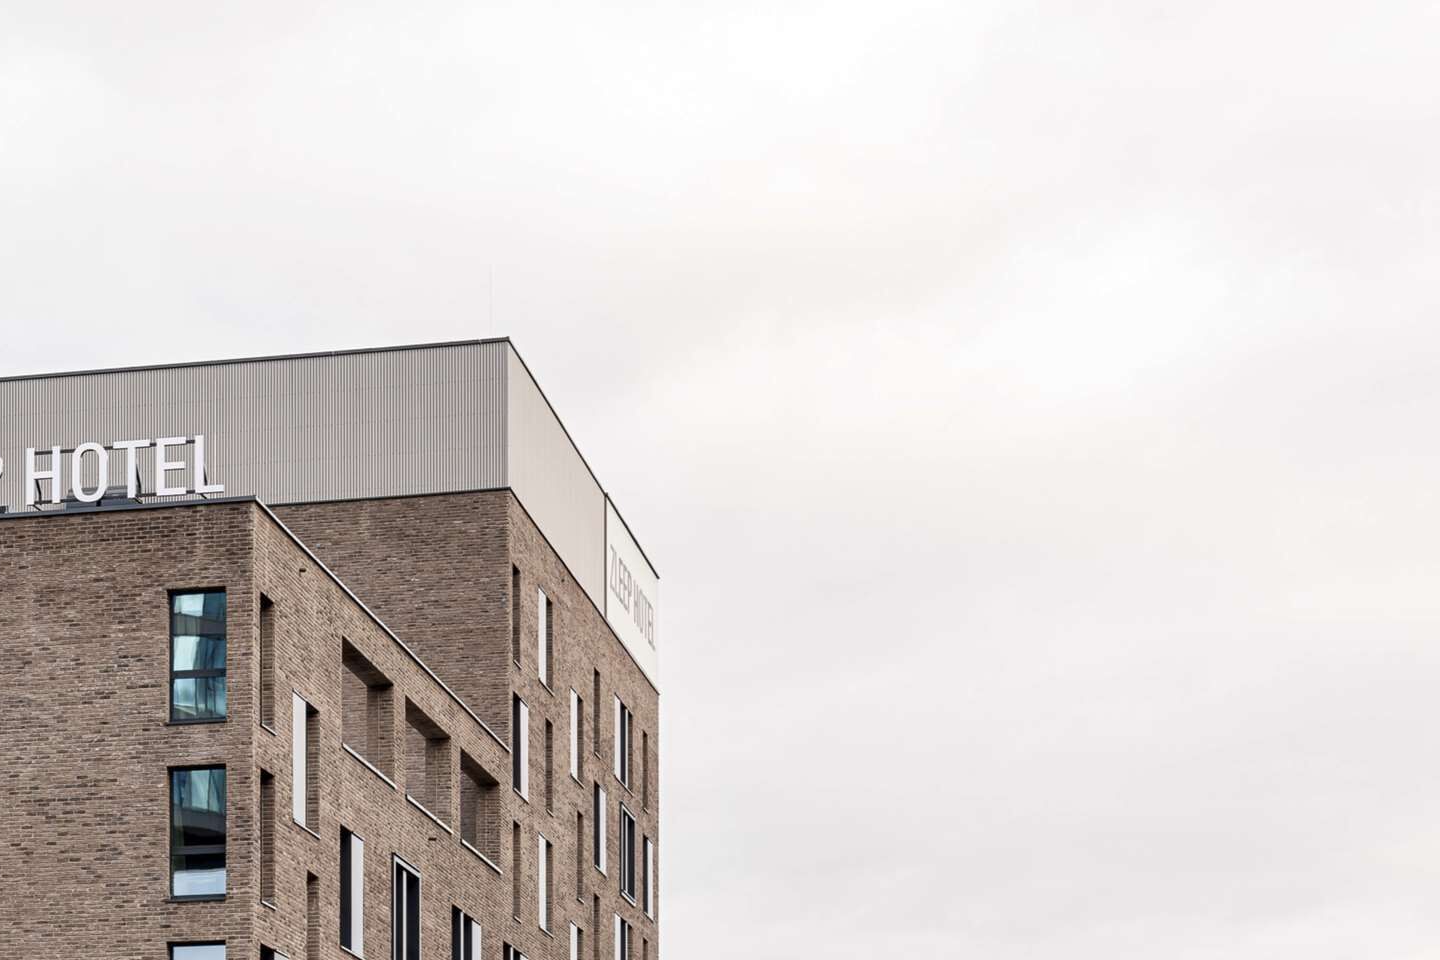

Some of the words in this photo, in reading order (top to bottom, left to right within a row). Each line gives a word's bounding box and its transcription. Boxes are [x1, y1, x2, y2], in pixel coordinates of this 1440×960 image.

[26, 435, 225, 505] HOTEL
[610, 543, 632, 614] ZLEEP
[633, 579, 656, 652] HOTEL
